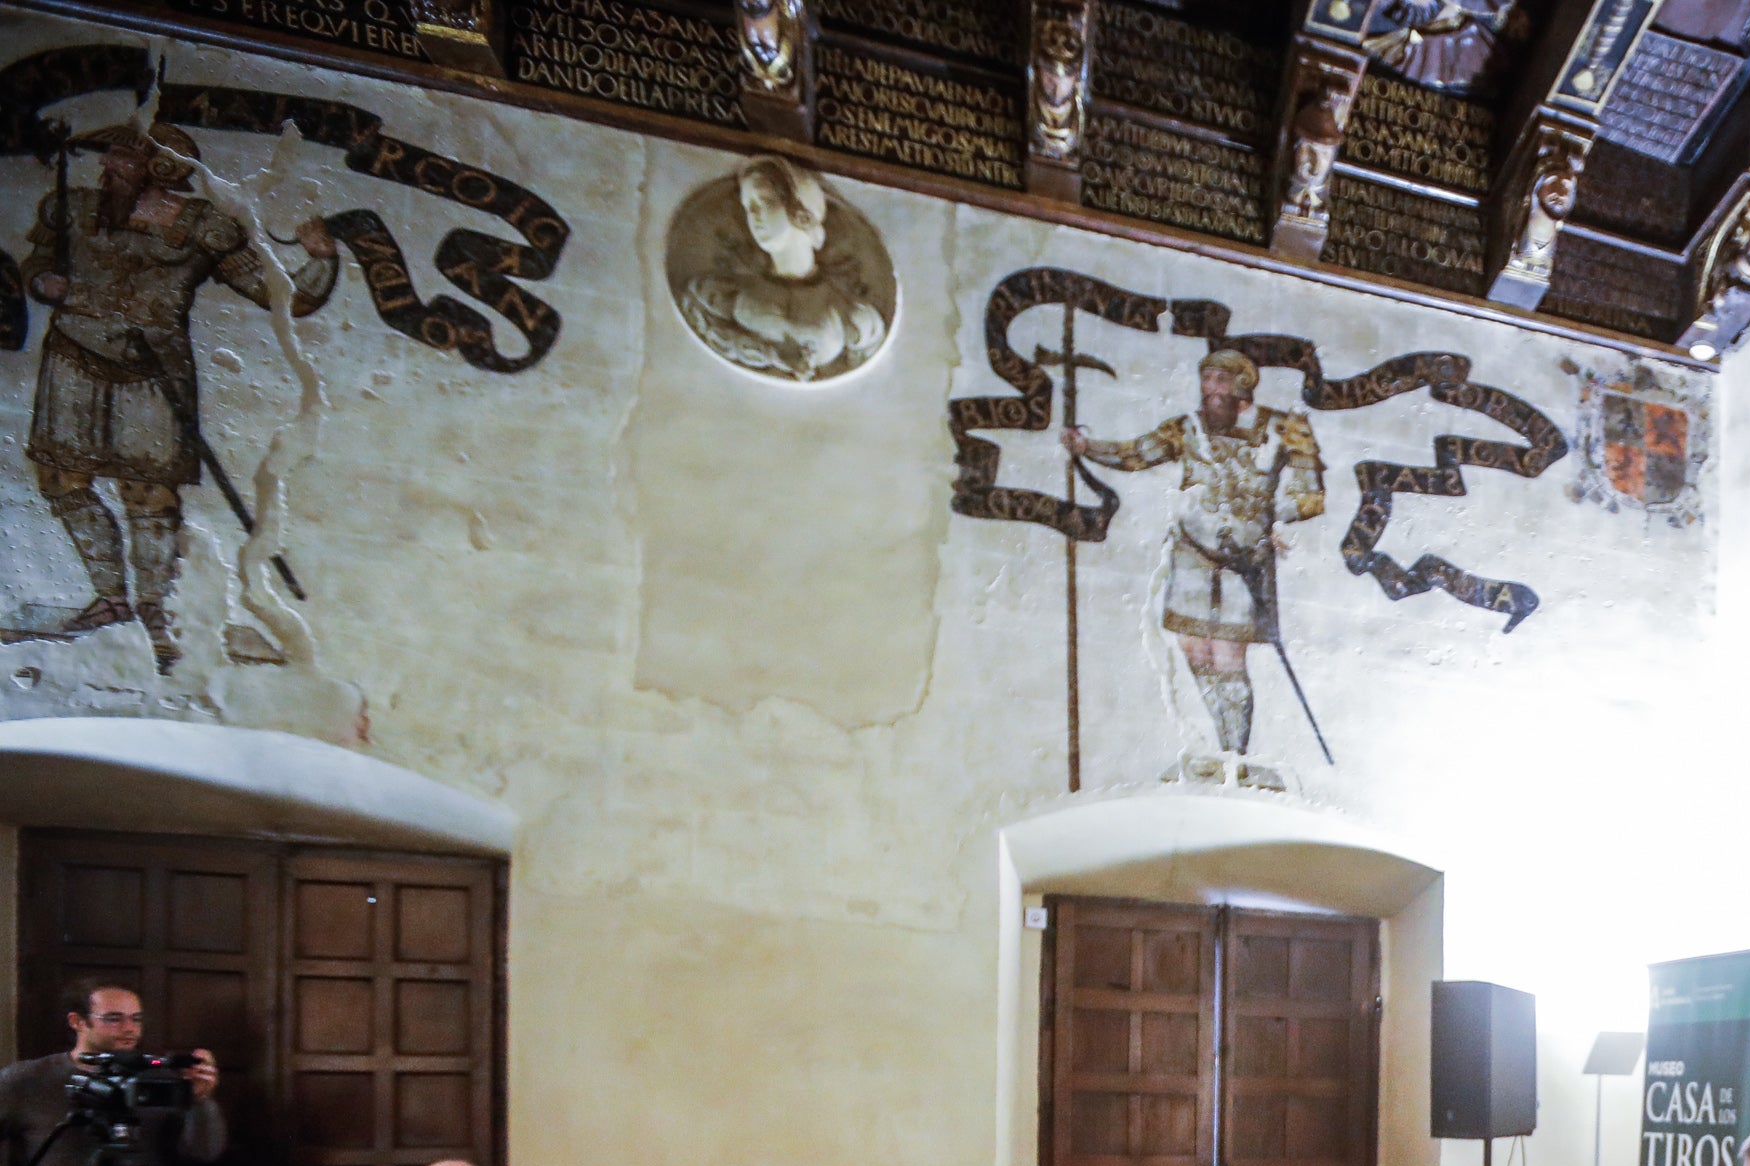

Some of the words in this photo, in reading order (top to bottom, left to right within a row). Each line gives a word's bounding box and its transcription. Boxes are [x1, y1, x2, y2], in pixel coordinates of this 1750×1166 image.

[1648, 1060, 1685, 1077] MUSEO
[1646, 1081, 1717, 1125] CASA
[1719, 1087, 1734, 1104] DE
